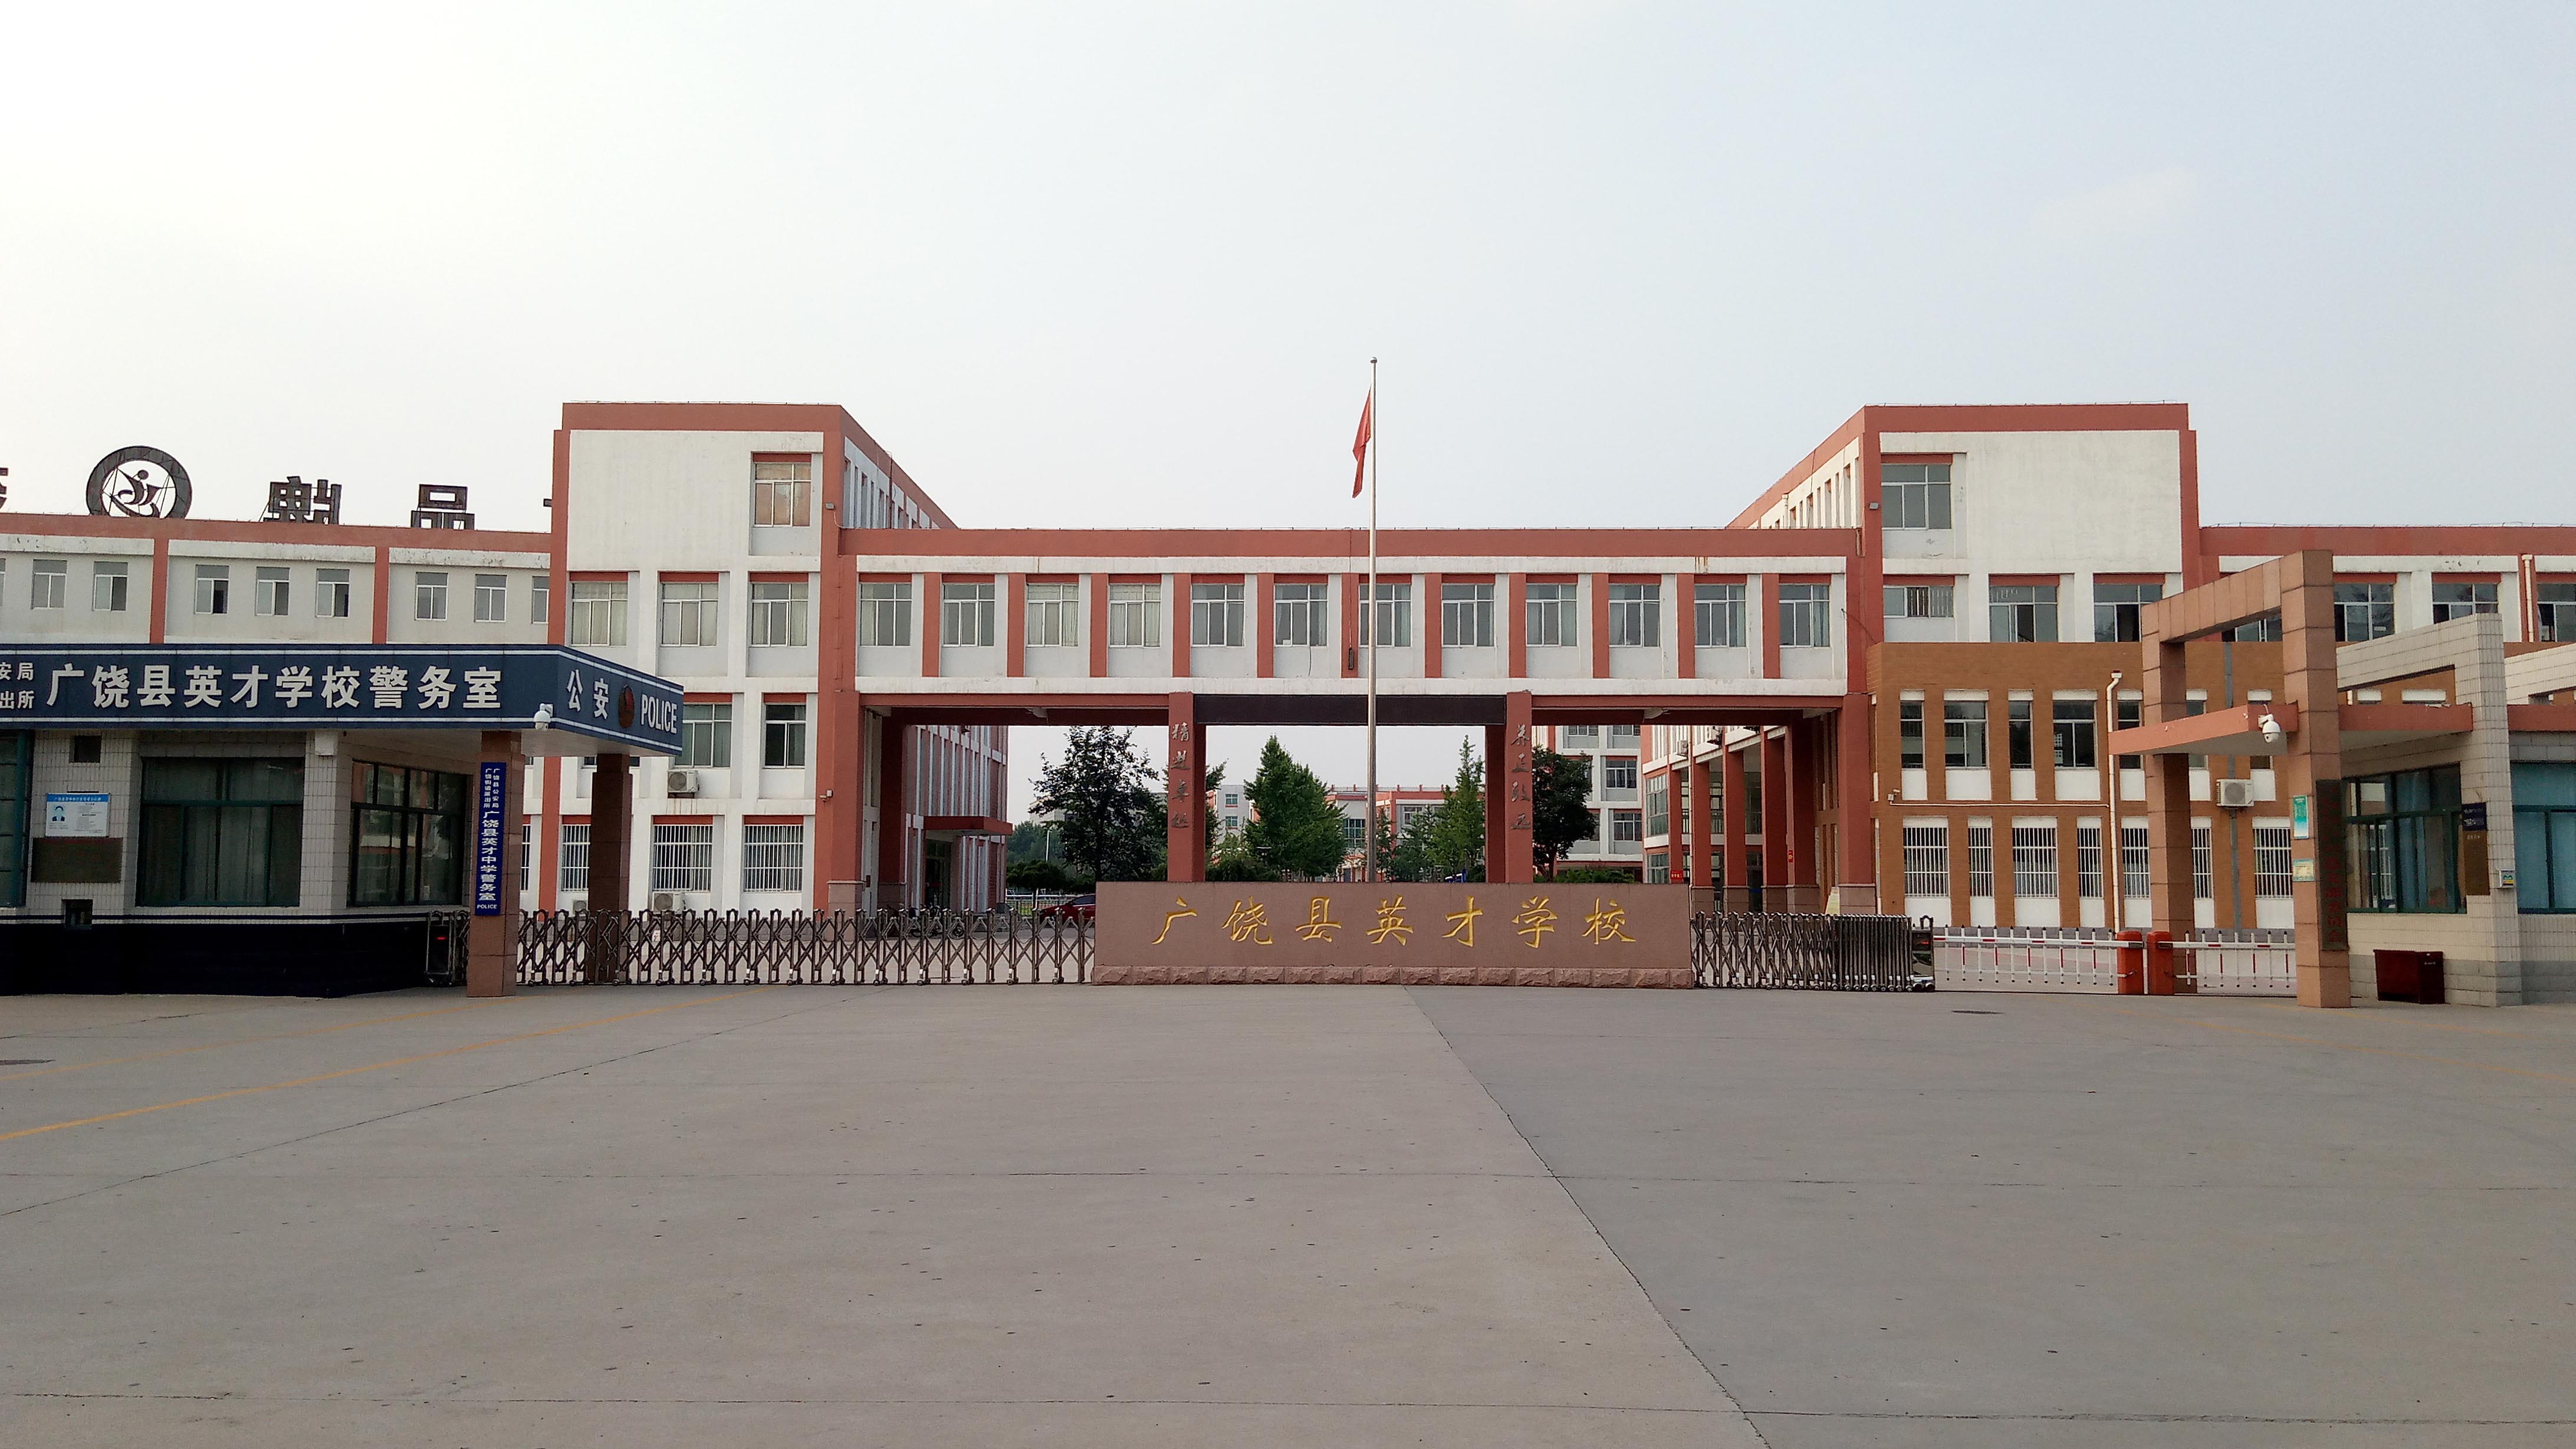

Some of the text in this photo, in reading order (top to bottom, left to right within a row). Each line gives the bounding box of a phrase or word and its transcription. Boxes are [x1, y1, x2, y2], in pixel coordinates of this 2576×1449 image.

[0, 661, 34, 681] 安局
[46, 662, 502, 709] 广饶县英才学校警务室
[0, 690, 35, 709] 出所
[566, 669, 609, 720] 公安
[640, 693, 678, 734] POLICE
[483, 768, 492, 808] 广饶街道派出所
[492, 768, 501, 808] 广饶县公安局
[478, 810, 500, 901] 广饶县英才中学警务室
[1152, 896, 1636, 948] 广饶县英才学校
